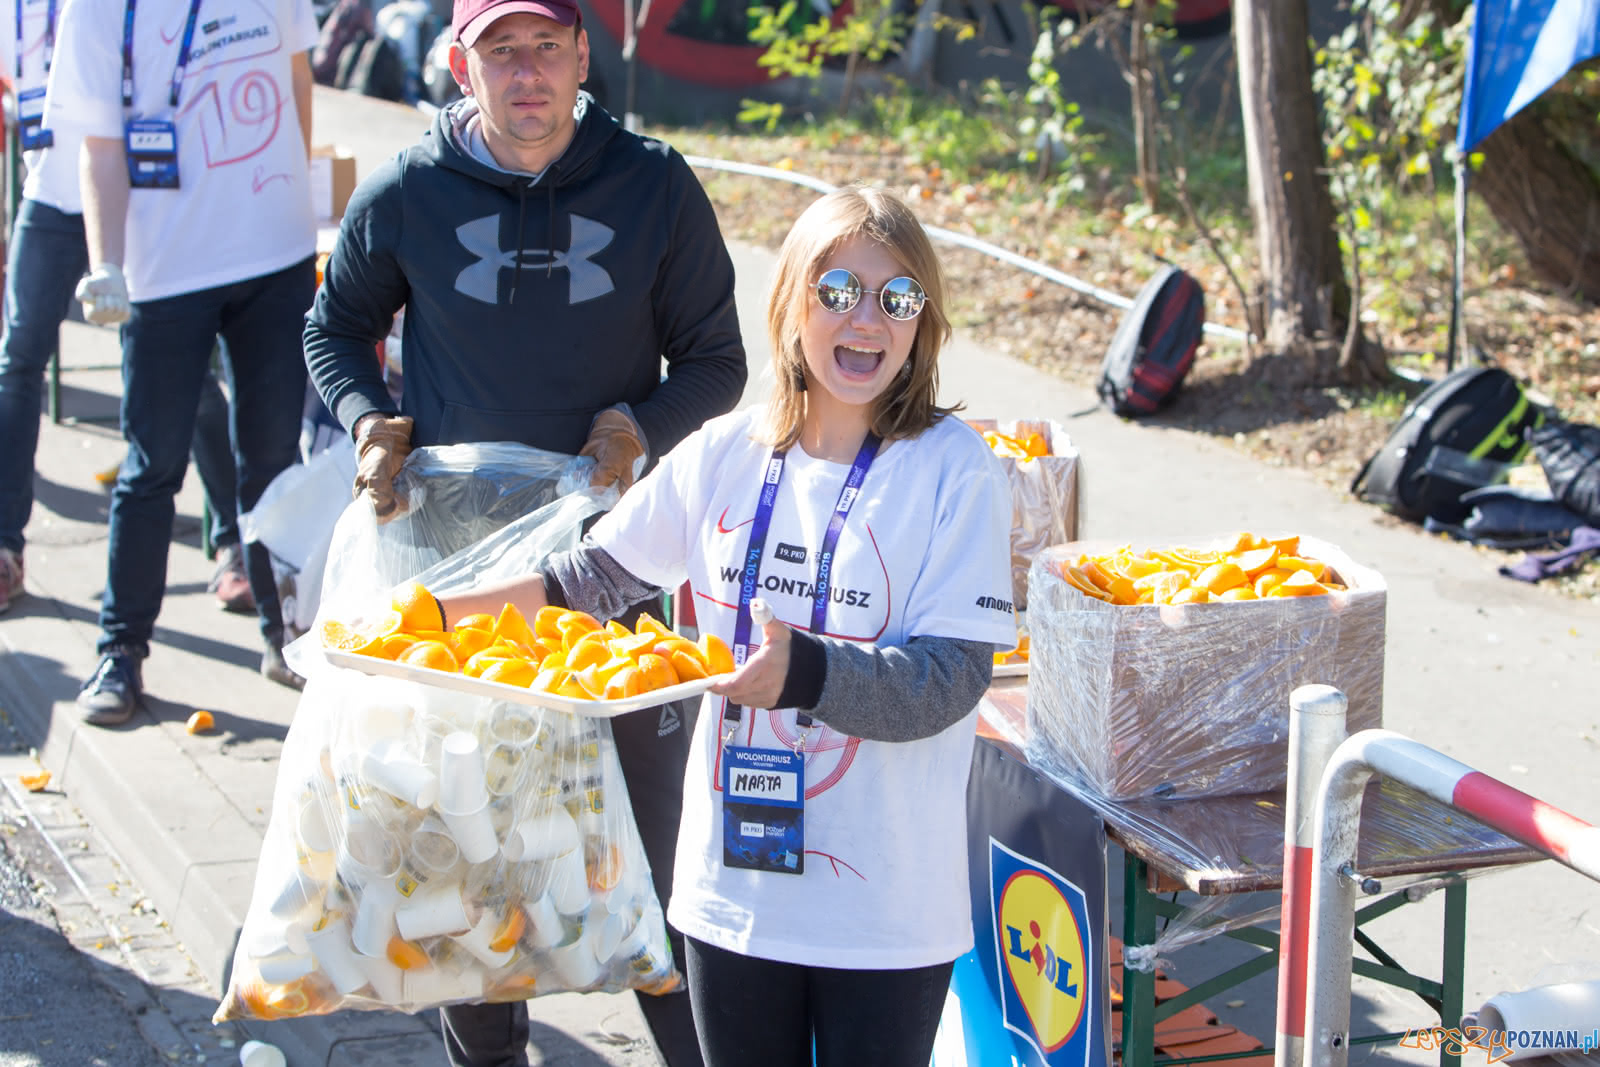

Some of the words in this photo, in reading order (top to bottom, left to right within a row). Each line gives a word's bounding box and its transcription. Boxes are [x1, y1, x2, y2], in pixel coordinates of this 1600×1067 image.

[790, 549, 805, 560] PKO
[741, 547, 761, 605] 14.10.2018
[816, 552, 832, 609] 14.10.2018
[657, 720, 681, 737] Reebok
[735, 751, 792, 764] WOLONTARIUSZ
[734, 773, 782, 793] MARTA
